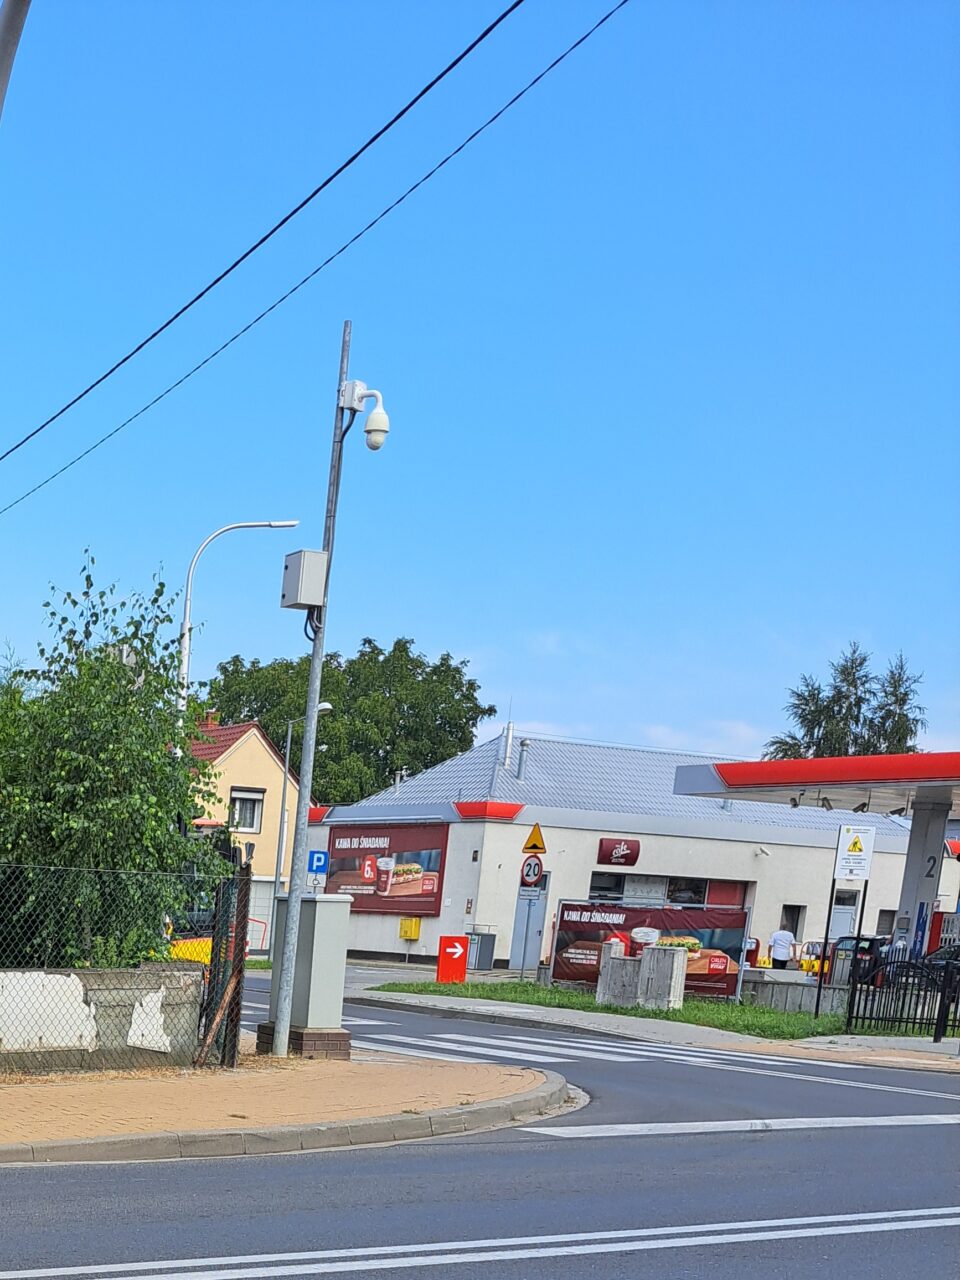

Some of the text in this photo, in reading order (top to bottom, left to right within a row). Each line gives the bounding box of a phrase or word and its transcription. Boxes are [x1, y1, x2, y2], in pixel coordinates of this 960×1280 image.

[335, 835, 390, 849] KAWA DO ŚNIADANIA!
[312, 854, 325, 871] P
[363, 860, 372, 879] 6
[524, 862, 540, 878] 20
[924, 855, 937, 878] 2
[563, 909, 626, 924] KAWA DO ŚNIADANIA!
